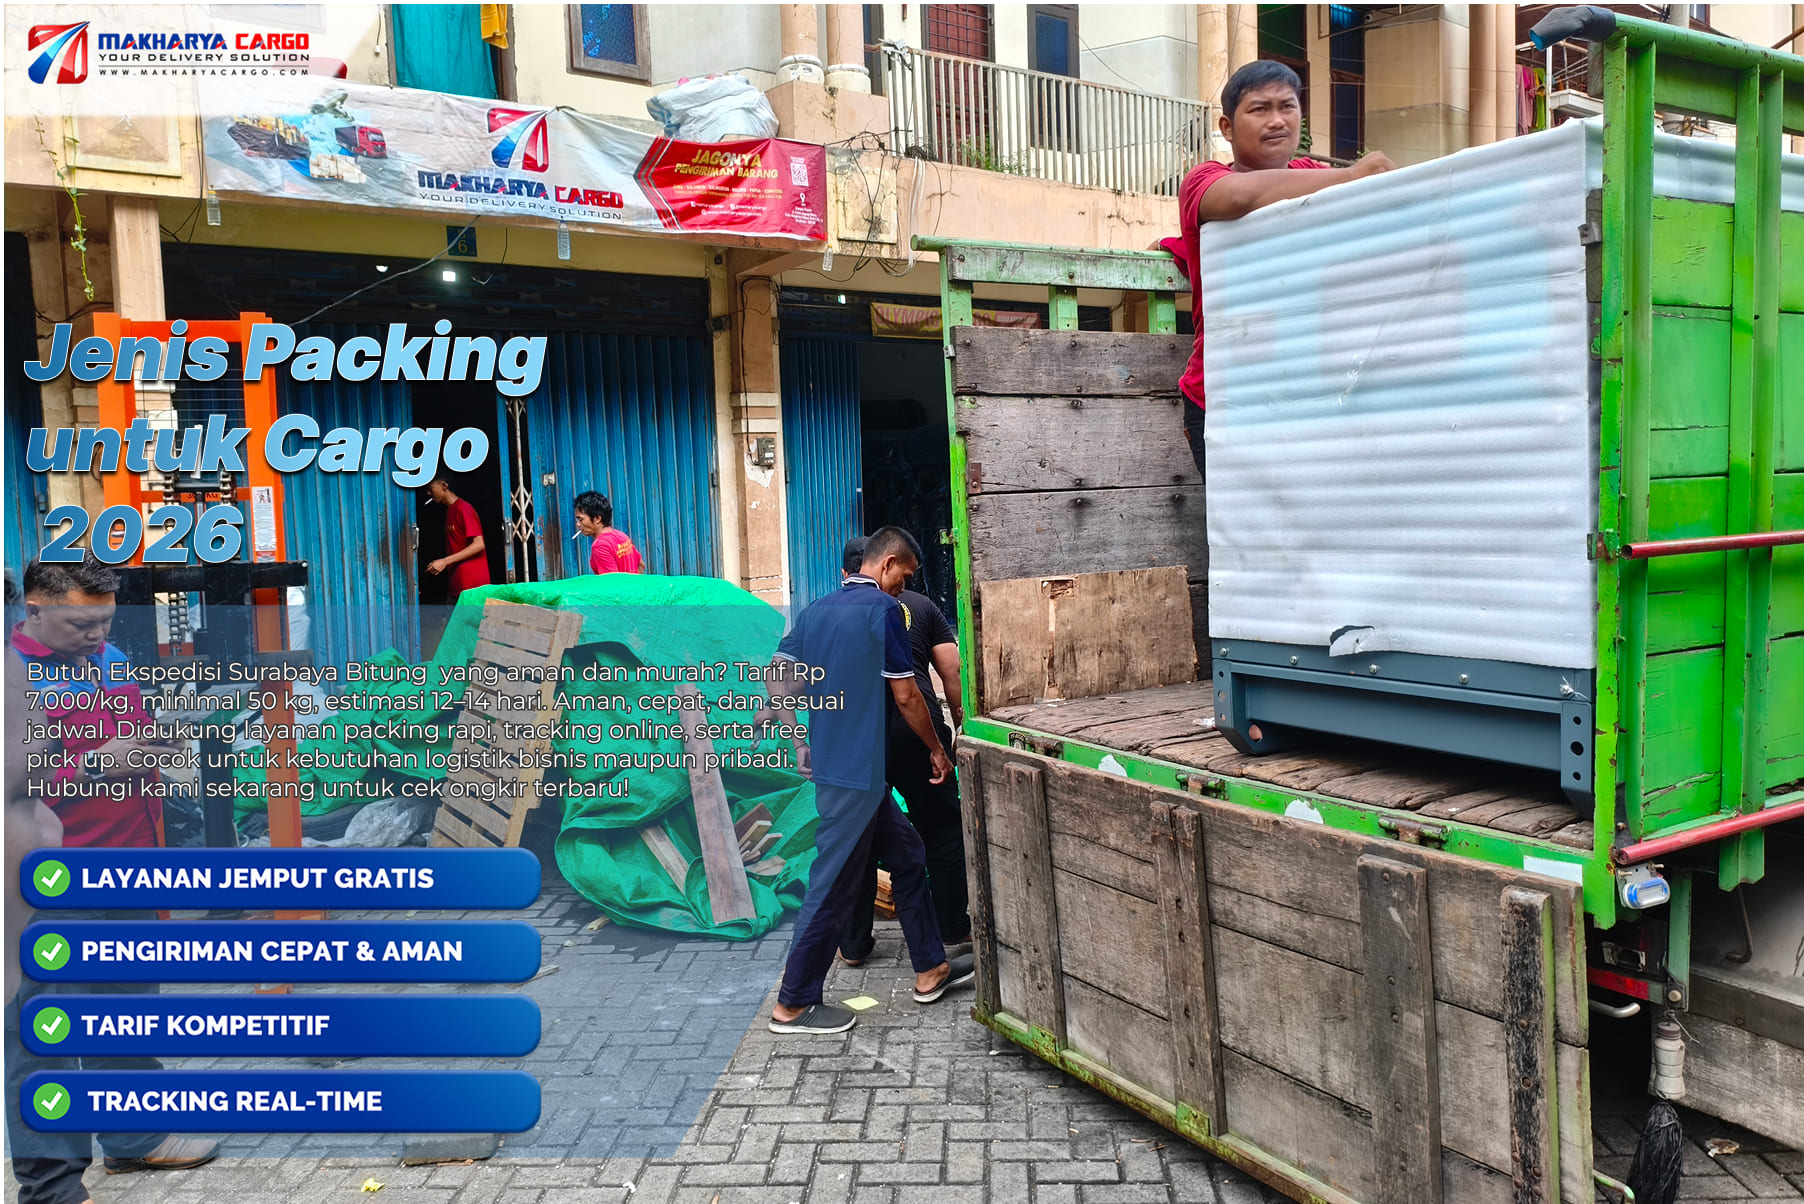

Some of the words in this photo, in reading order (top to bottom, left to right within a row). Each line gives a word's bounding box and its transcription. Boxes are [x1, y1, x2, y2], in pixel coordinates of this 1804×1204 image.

[691, 149, 762, 168] JAGONYA
[674, 163, 735, 178] PENGIRIMAN
[737, 167, 779, 179] BARANG
[417, 171, 549, 199] MAKHARYA
[554, 185, 624, 209] CARGO
[418, 192, 464, 203] YOUR
[469, 197, 546, 210] DELIVERY
[549, 206, 622, 220] SOLUTION
[875, 305, 940, 328] OLYMPIC
